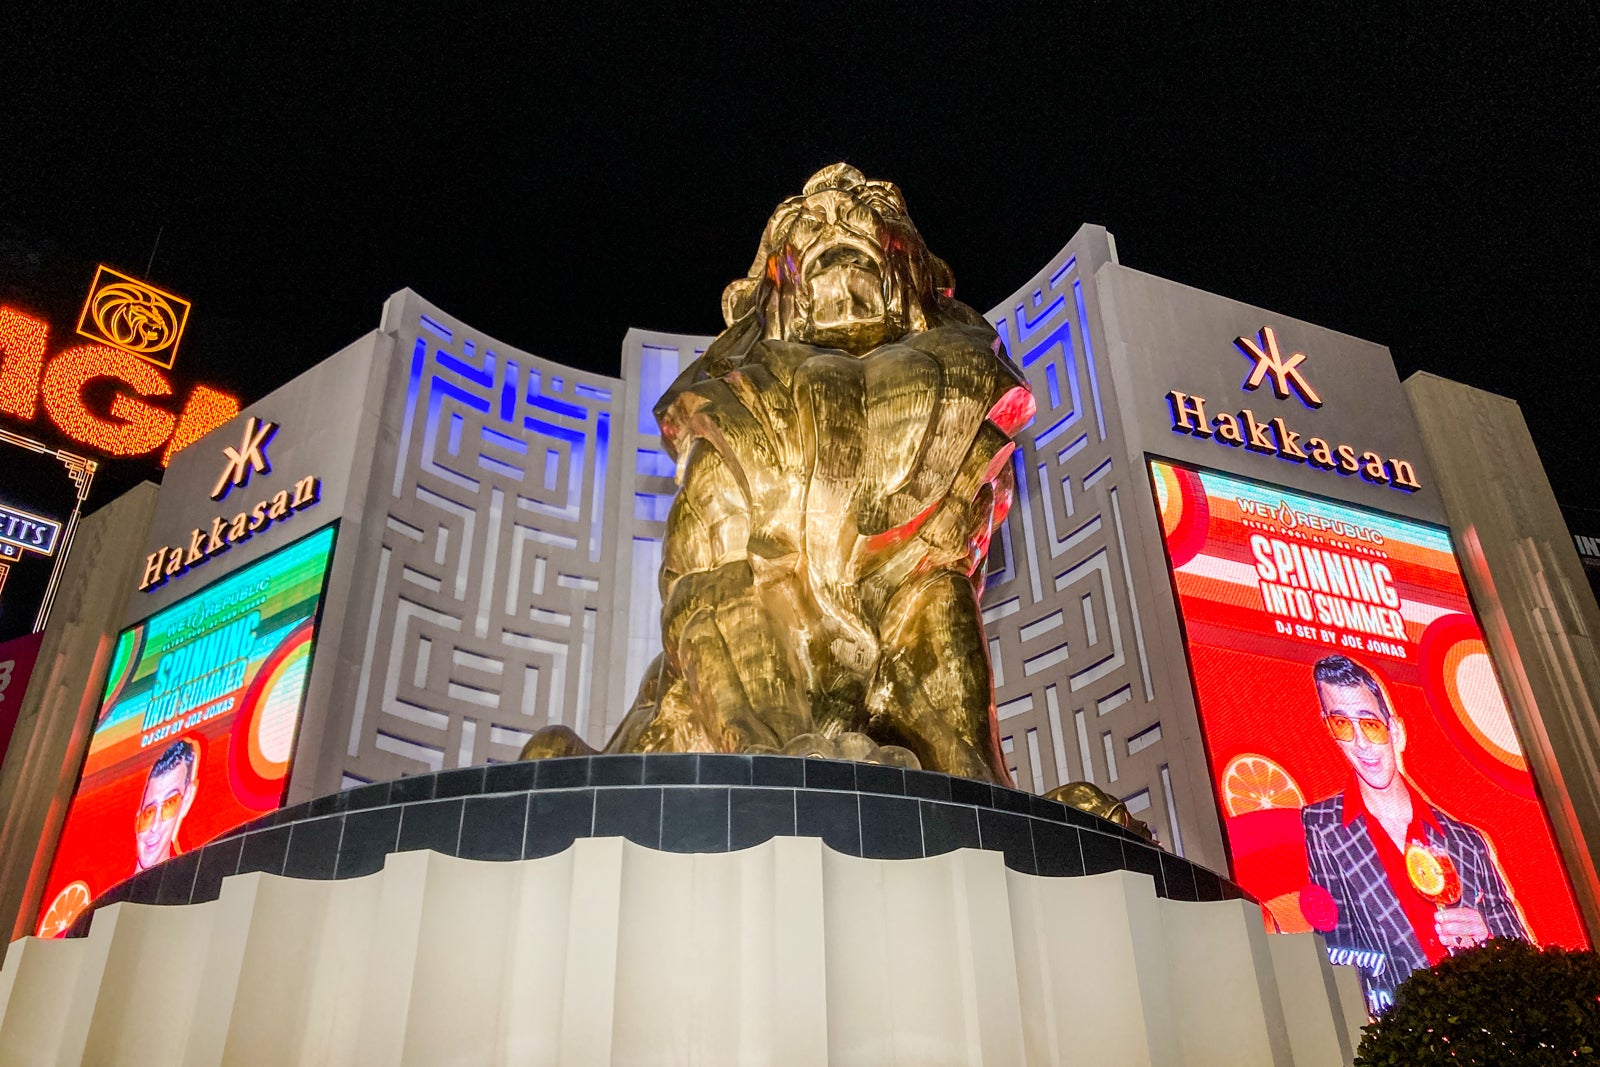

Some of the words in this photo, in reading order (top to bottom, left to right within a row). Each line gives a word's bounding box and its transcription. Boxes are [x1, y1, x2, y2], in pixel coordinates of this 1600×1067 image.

[1167, 390, 1422, 491] Hakkasan
[139, 475, 318, 591] Hakkasan
[1236, 497, 1281, 520] WET
[1295, 510, 1385, 546] REPUBLIC
[1574, 534, 1600, 557] IN
[1250, 534, 1400, 609] SPINNING
[1261, 580, 1315, 622] INTO
[1313, 592, 1409, 642] SUMMER
[1275, 620, 1293, 636] DJ
[1295, 624, 1318, 641] SET
[1320, 629, 1337, 645] BY
[1341, 634, 1365, 650] JOE
[1366, 639, 1407, 659] JONAS
